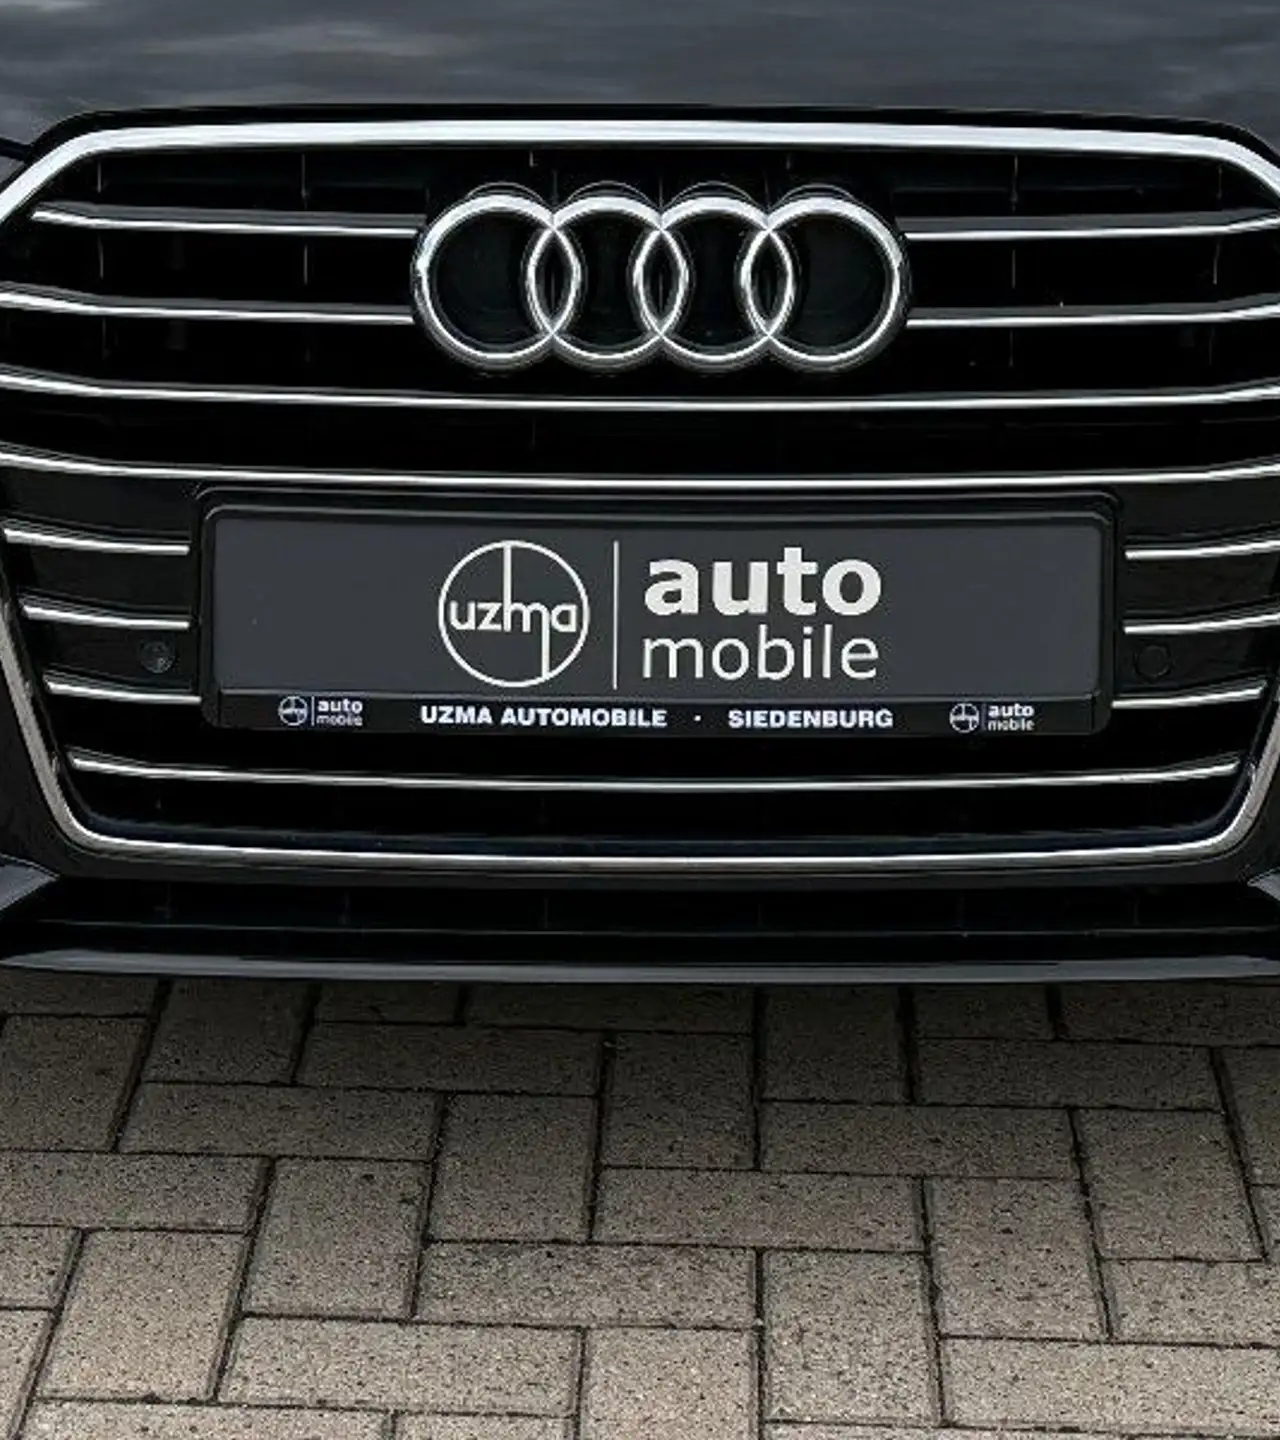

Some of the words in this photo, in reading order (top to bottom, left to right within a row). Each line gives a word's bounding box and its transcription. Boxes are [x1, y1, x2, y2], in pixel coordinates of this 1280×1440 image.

[644, 547, 882, 616] auto
[642, 623, 879, 680] mobile
[317, 698, 363, 714] auto
[420, 705, 493, 725] UZMA
[500, 707, 668, 728] AUTOMOBILE
[727, 709, 895, 729] SIEDENBURG
[988, 703, 1035, 718] auto
